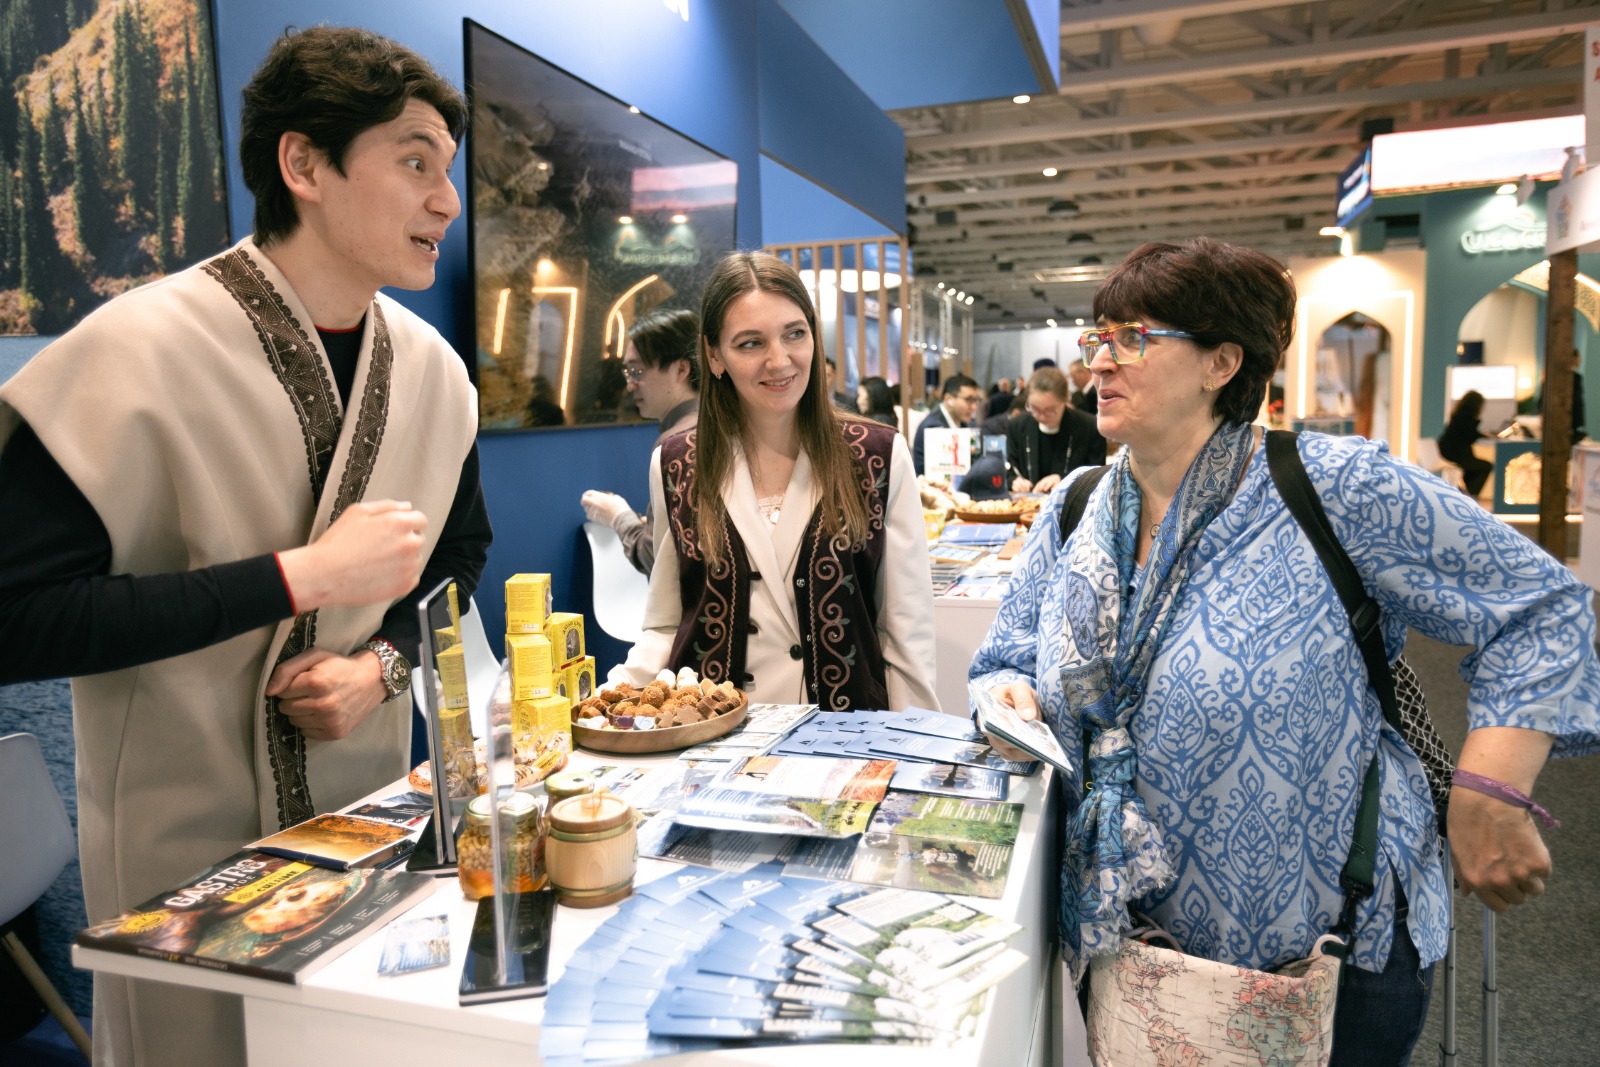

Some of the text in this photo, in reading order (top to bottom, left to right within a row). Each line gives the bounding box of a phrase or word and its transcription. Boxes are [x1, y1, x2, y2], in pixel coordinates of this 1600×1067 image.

[164, 858, 267, 907] GASTRO
[216, 874, 256, 896] GUIDE
[256, 870, 299, 892] CUISINE
